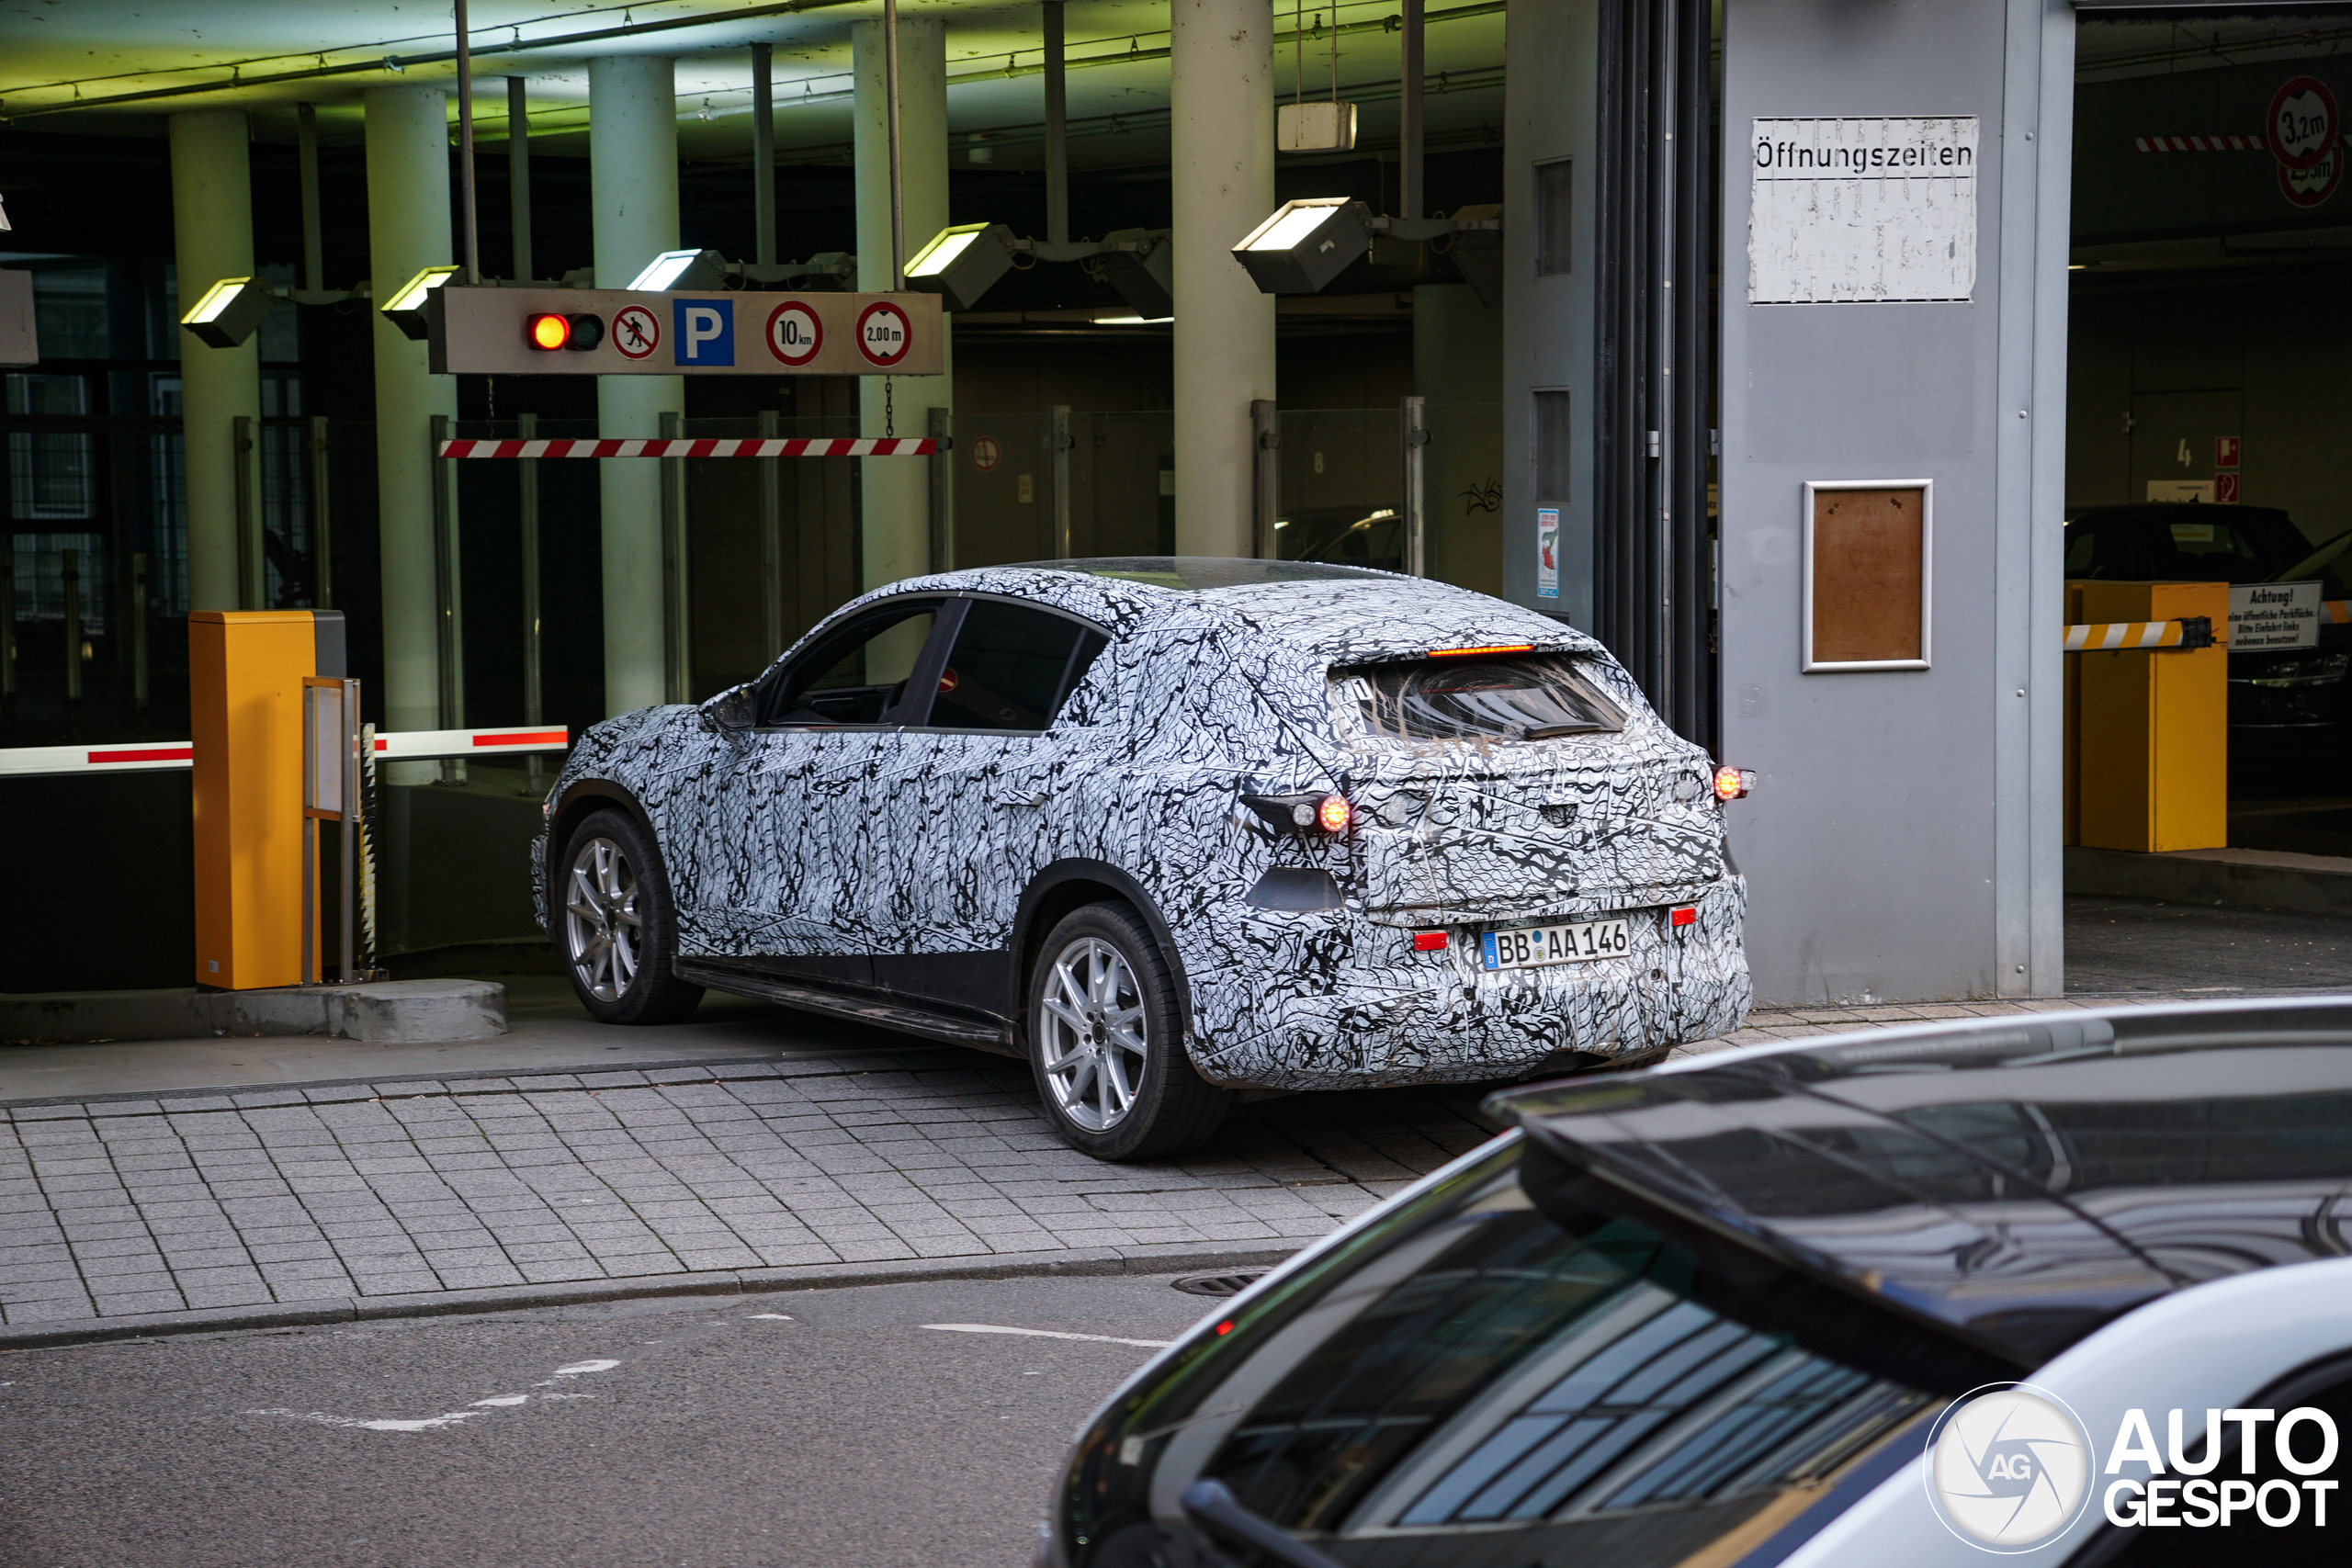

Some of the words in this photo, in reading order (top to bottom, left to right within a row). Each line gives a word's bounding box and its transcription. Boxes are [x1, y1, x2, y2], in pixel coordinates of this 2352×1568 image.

[2282, 111, 2325, 144] 3,2m
[1756, 136, 1972, 174] Öffnungszeiten
[685, 308, 723, 358] P
[779, 321, 797, 345] 10
[798, 333, 812, 345] km
[891, 328, 901, 342] m
[1314, 451, 1324, 474] 8
[2177, 438, 2192, 468] 4
[2250, 588, 2293, 606] Achtung!
[2228, 612, 2242, 622] eine
[2243, 609, 2278, 621] öffentliche
[2238, 623, 2254, 634] Bitte
[2255, 622, 2281, 633] Einfahrt
[2283, 620, 2300, 632] links
[1498, 934, 1531, 964] BB
[1549, 929, 1579, 959] AA
[1583, 923, 1626, 955] 146
